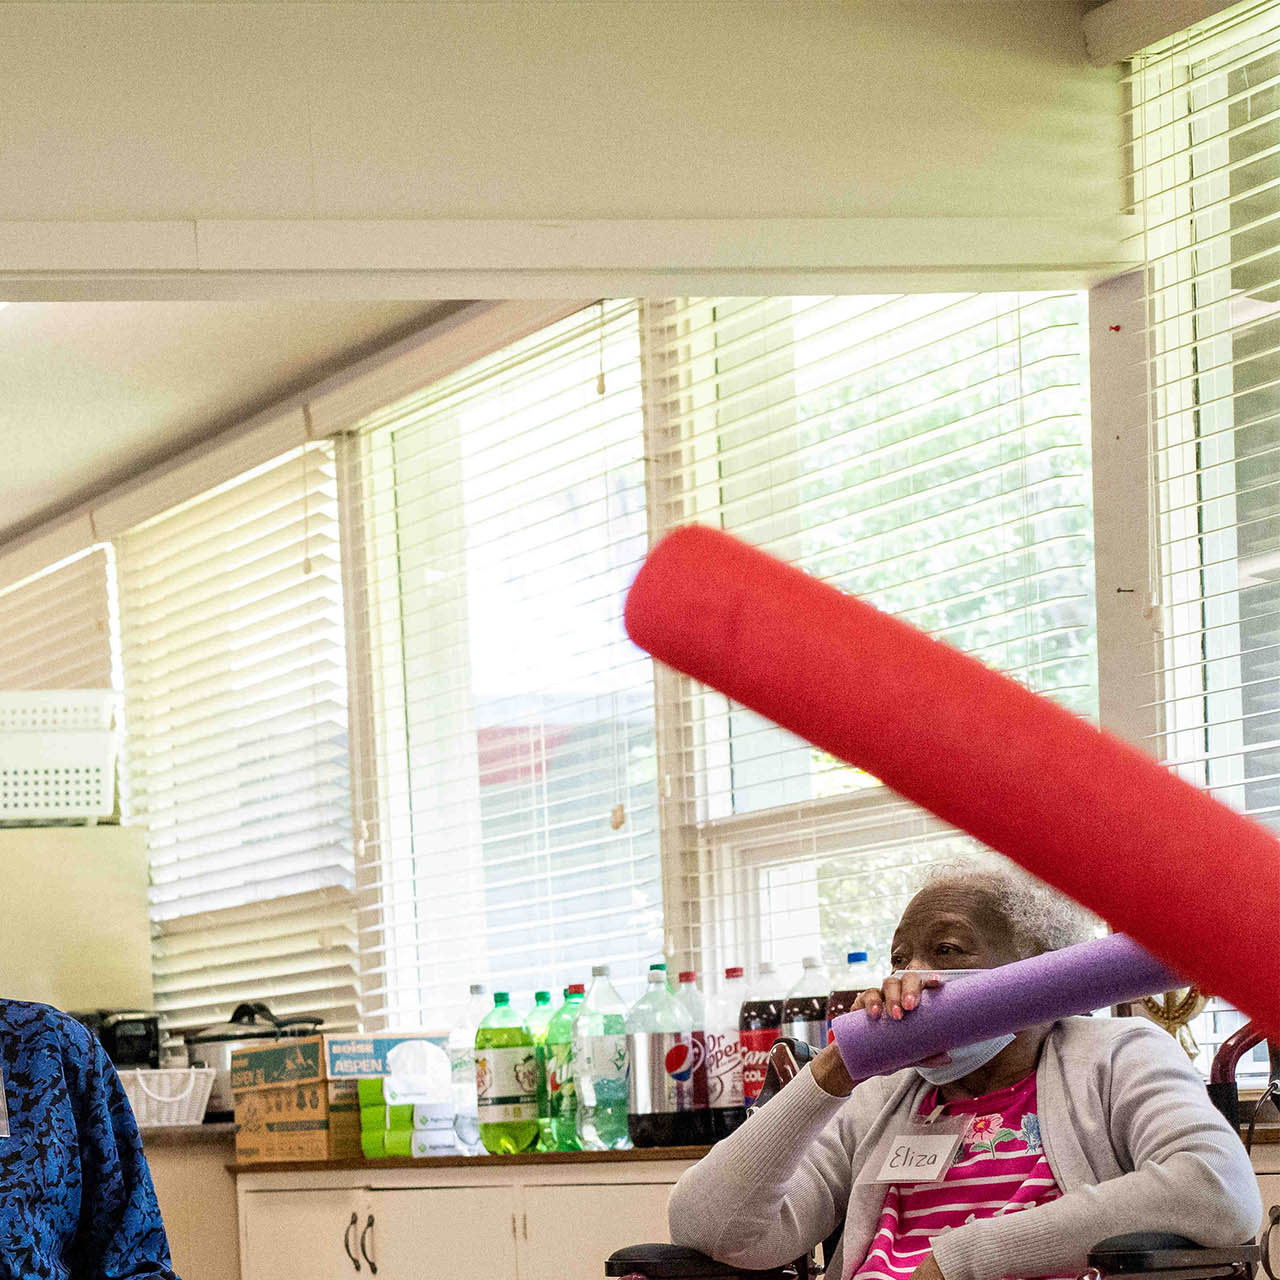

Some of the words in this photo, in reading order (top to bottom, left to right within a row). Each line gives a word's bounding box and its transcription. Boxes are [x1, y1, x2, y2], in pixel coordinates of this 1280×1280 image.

[334, 1059, 383, 1073] ASPEN
[743, 1070, 765, 1082] COL
[889, 1145, 938, 1169] Eliza
